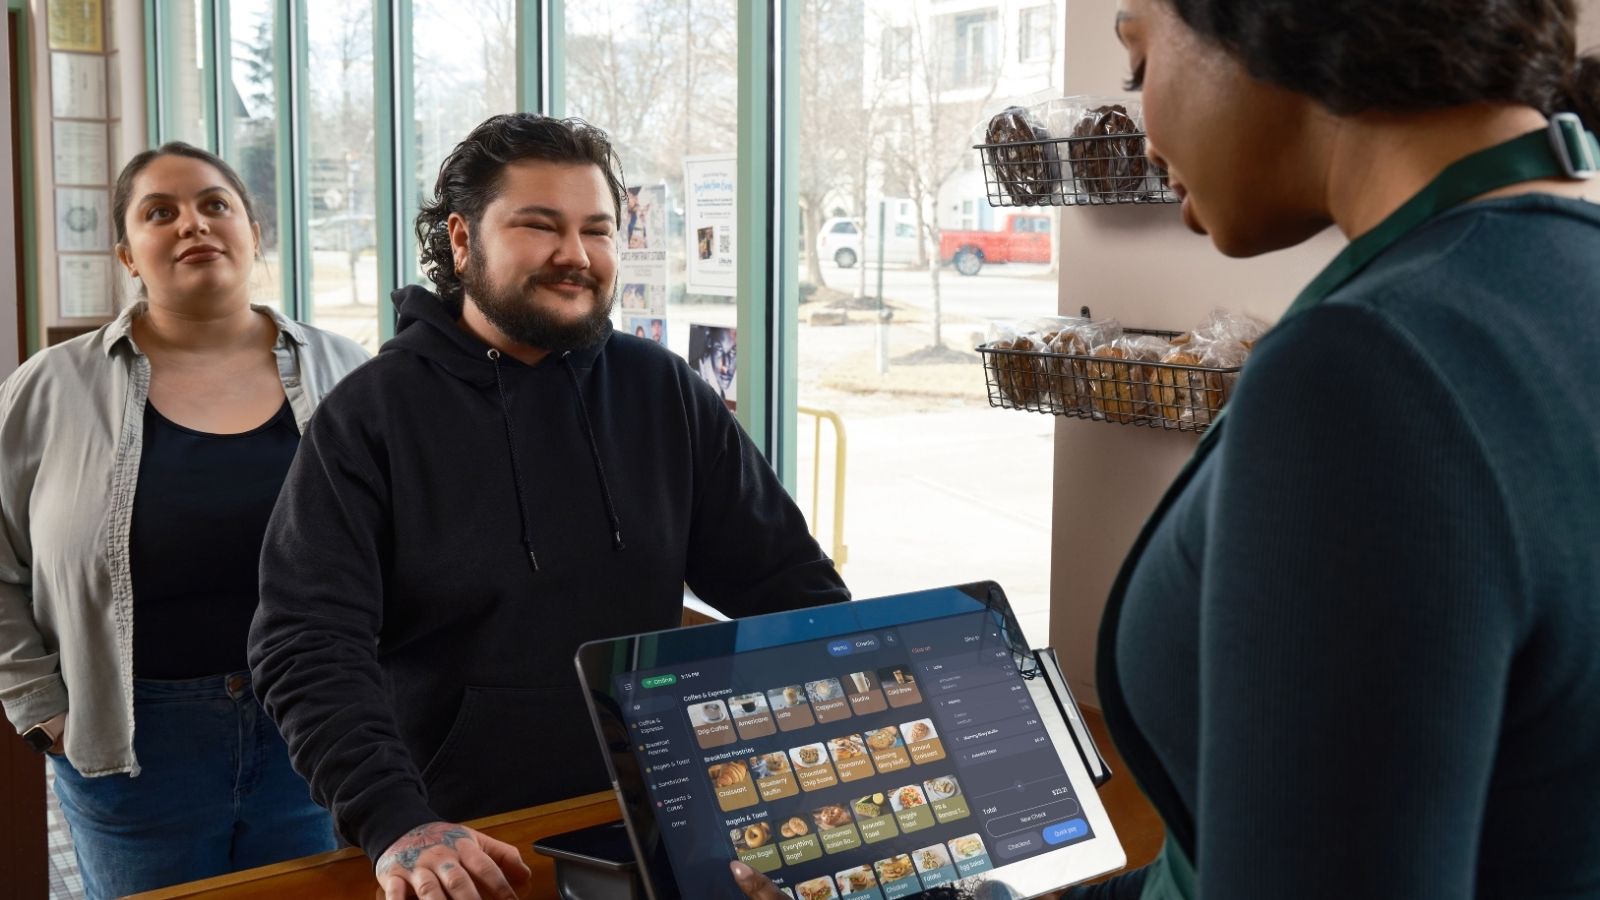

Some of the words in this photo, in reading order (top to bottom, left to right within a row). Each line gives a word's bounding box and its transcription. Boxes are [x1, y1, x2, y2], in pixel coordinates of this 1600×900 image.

[653, 677, 673, 685] Online
[738, 716, 769, 727] Americano
[912, 744, 930, 752] Almond
[704, 752, 731, 762] Breakfast
[732, 747, 754, 756] Pastries
[914, 751, 938, 760] Croissant
[838, 760, 866, 769] Cinnamon
[800, 768, 827, 778] Chocolate
[761, 778, 787, 788] Blueberry
[719, 787, 747, 798] Croissant
[763, 788, 782, 796] Muffin
[982, 806, 997, 814] Total
[725, 816, 745, 826] Bagels
[752, 810, 768, 819] Toast
[899, 812, 917, 820] Veggie
[823, 829, 851, 840] Cinnamon
[783, 839, 813, 851] Everything
[757, 849, 774, 857] Bagel
[786, 851, 802, 861] Bagel
[970, 859, 985, 867] Salad
[886, 883, 908, 892] Chicken
